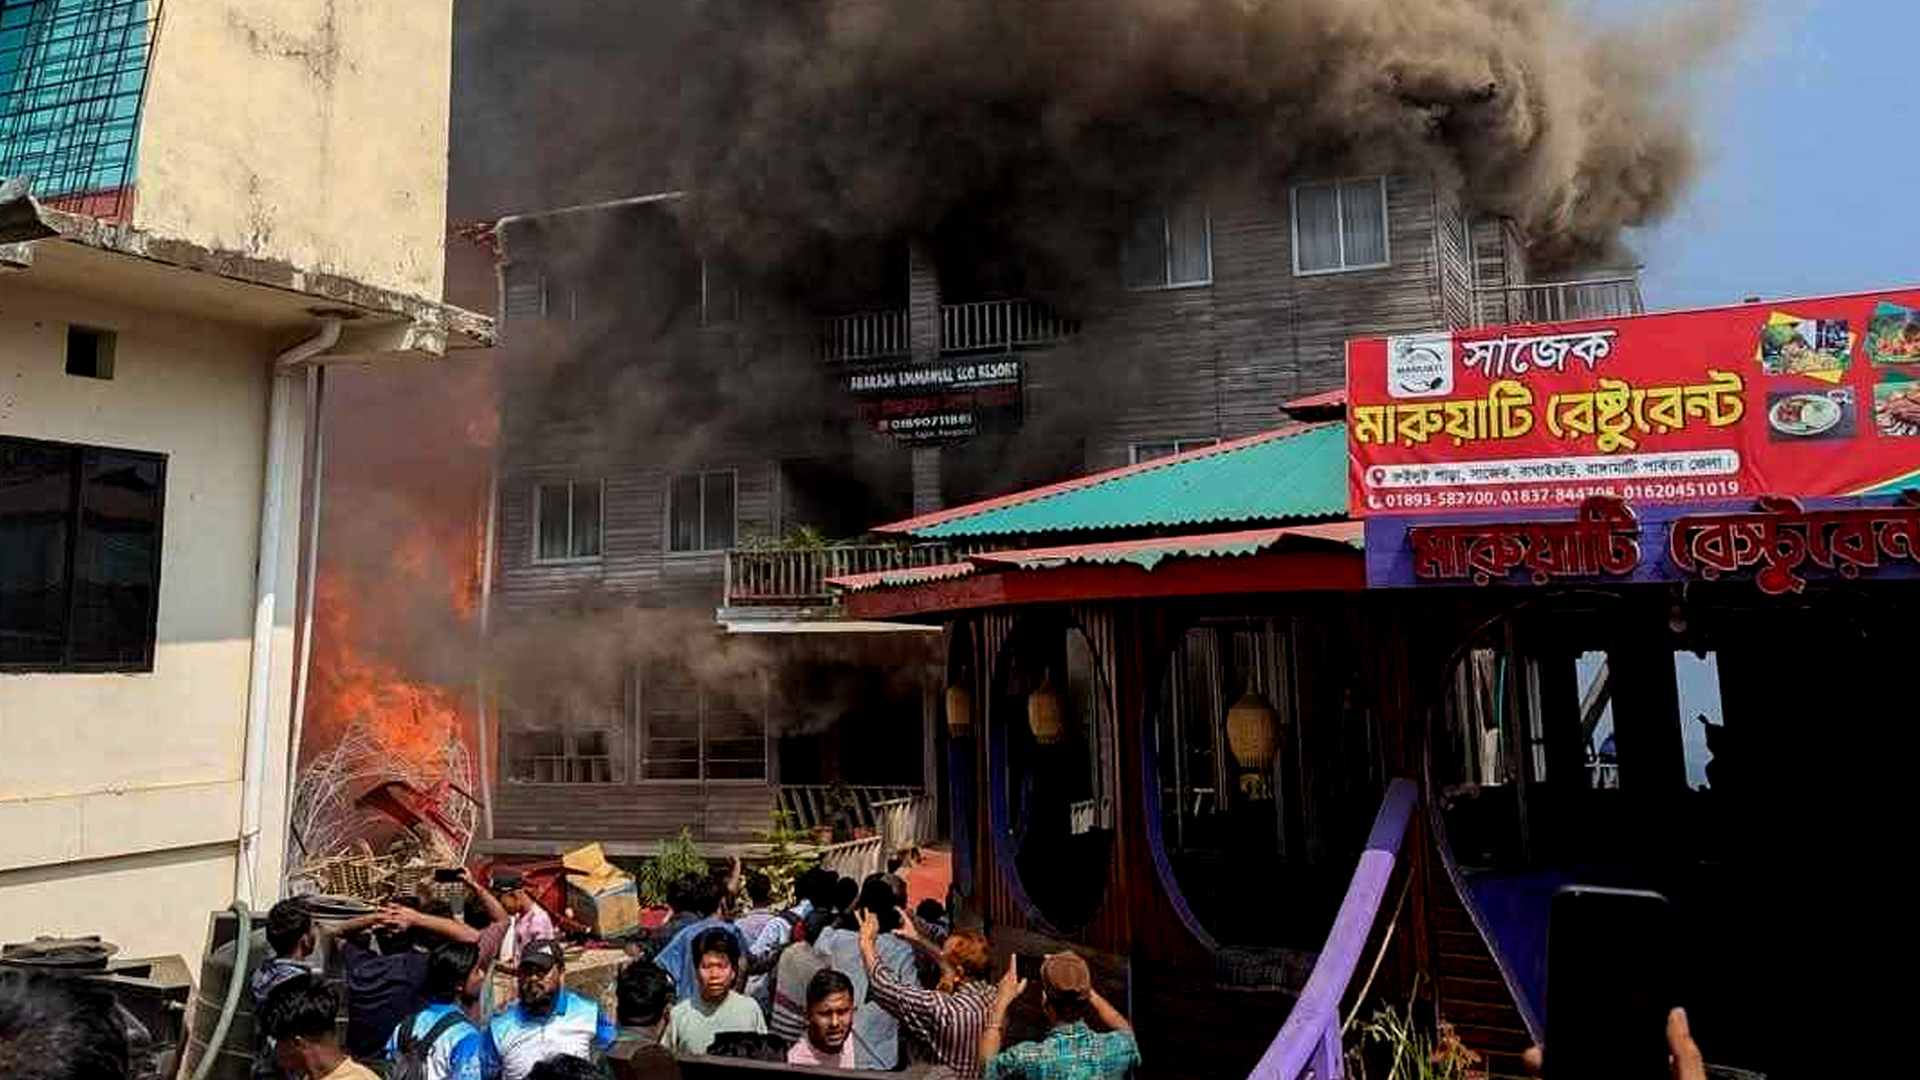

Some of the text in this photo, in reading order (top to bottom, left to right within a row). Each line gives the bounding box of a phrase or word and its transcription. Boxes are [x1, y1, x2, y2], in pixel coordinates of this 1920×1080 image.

[1461, 330, 1617, 378] সাজেক
[1353, 379, 1534, 448] মারুয়াটি
[1623, 480, 1739, 499] 01620451019
[1410, 496, 1641, 585] মারুয়াটি
